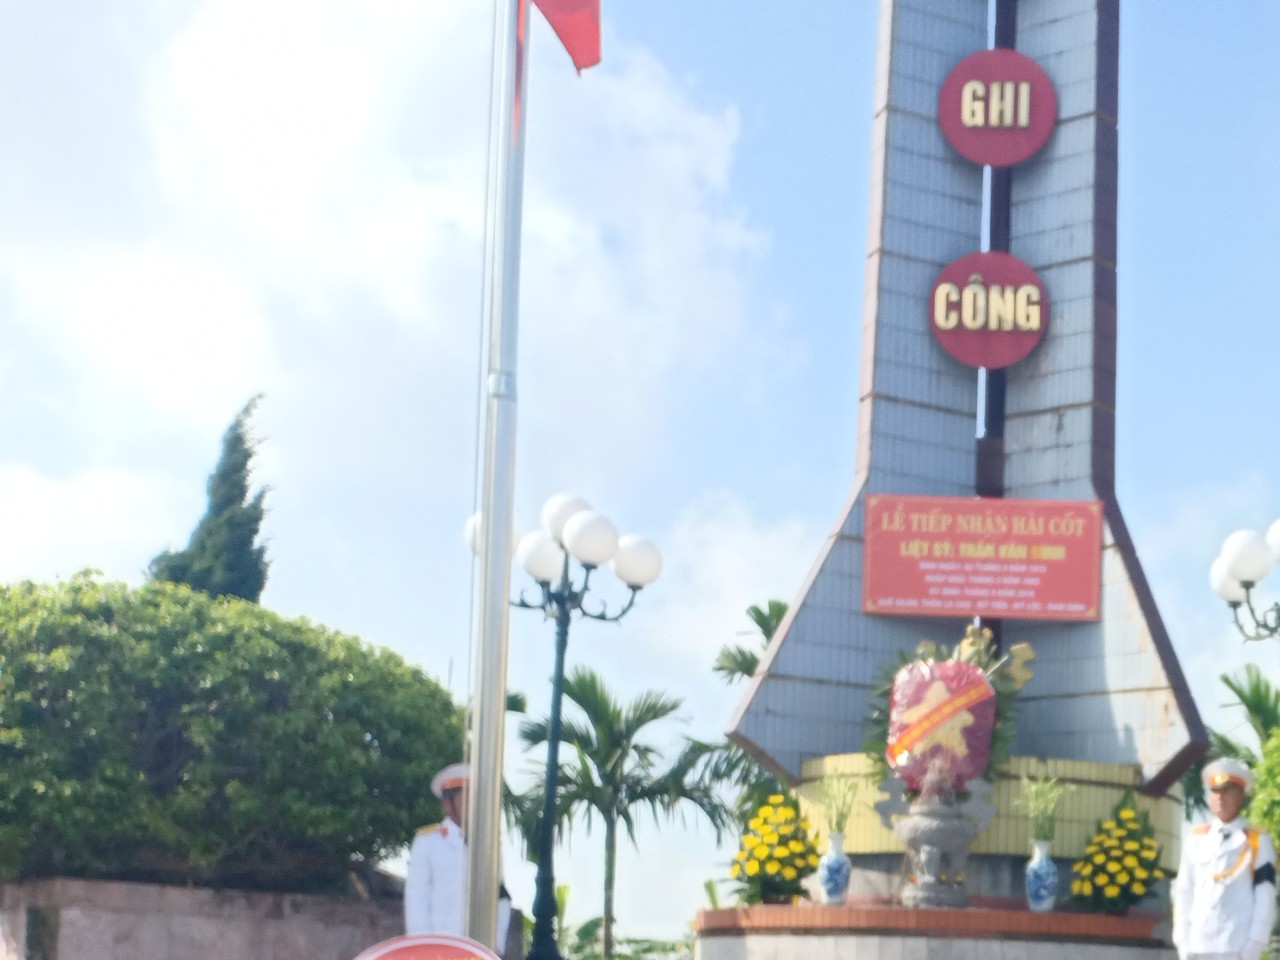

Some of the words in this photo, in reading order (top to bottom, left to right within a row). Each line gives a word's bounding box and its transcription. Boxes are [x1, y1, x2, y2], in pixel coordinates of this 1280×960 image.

[961, 80, 1031, 127] GHI
[934, 274, 1041, 331] CÔNG
[909, 507, 952, 533] TIẾP
[956, 510, 1008, 538] NHẬN
[1048, 512, 1087, 537] CỐT
